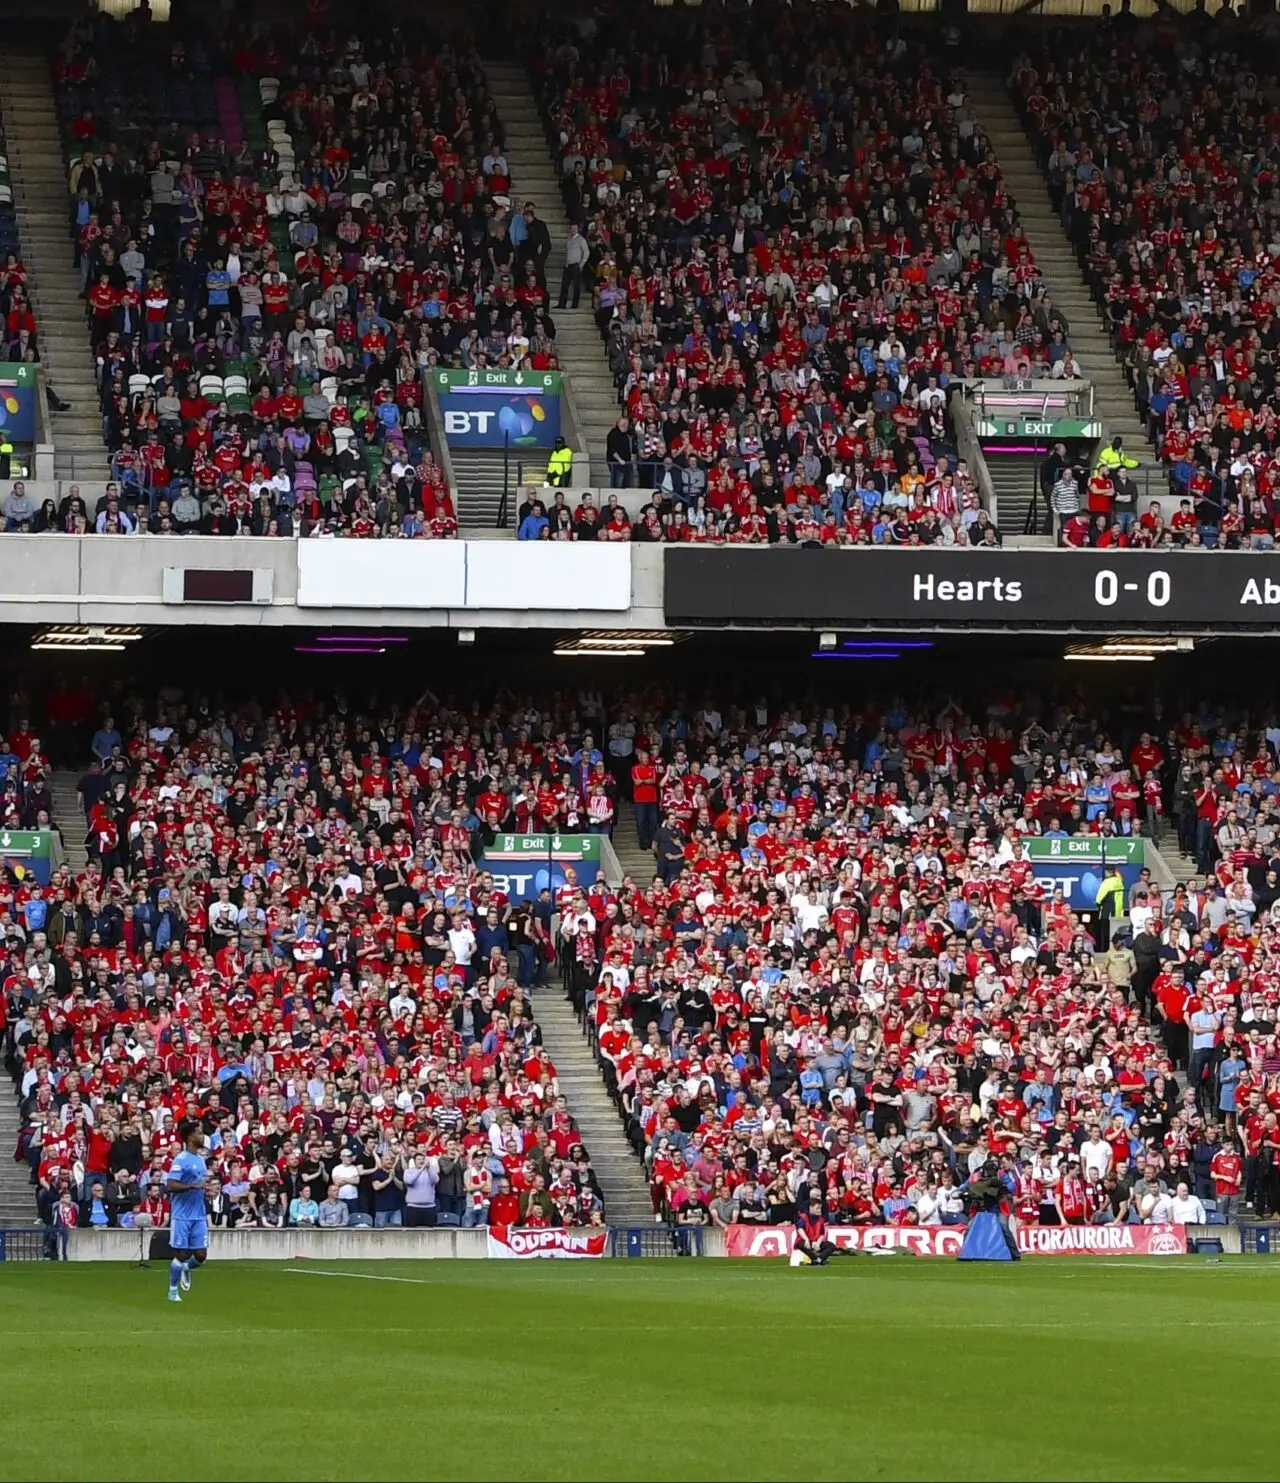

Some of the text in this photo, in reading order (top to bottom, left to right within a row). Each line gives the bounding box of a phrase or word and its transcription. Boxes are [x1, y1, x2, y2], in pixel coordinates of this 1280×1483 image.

[18, 367, 27, 378] 4
[440, 373, 553, 386] 6 Exit 6
[444, 410, 496, 434] BT
[1007, 422, 1054, 435] 8 EXIT
[912, 573, 1023, 601] Hearts
[1094, 570, 1171, 607] 0-0
[32, 836, 41, 848] 3
[522, 838, 591, 851] Exit 5
[1068, 841, 1091, 852] Exit
[1127, 842, 1136, 854] 7
[491, 874, 533, 896] BT
[631, 1236, 637, 1244] 3
[1260, 1234, 1266, 1244] 4
